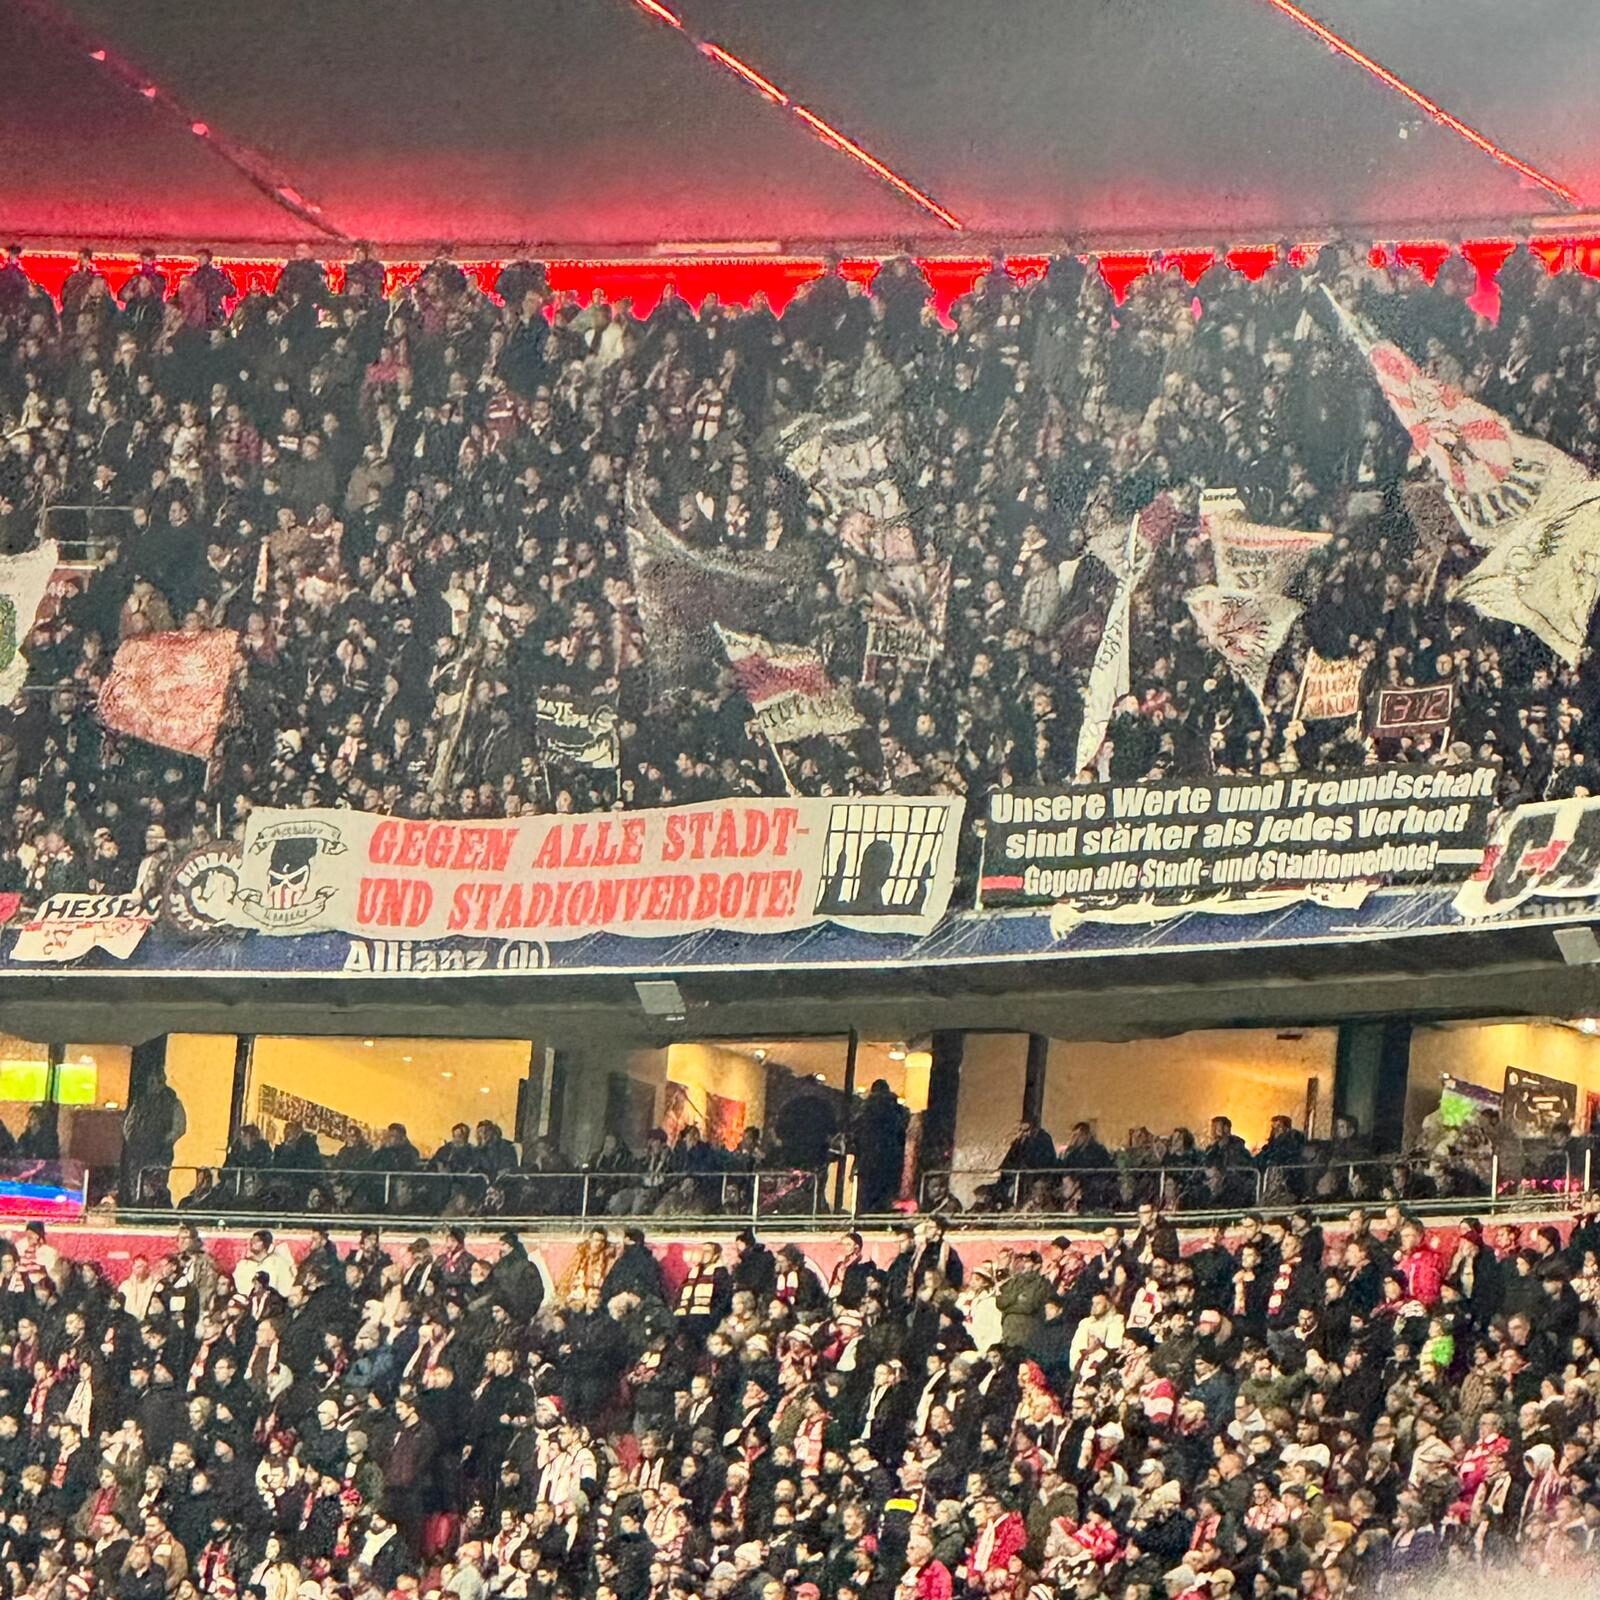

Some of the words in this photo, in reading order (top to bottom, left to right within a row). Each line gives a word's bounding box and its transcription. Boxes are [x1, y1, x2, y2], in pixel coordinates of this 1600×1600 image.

[990, 793, 1106, 824] Unsere
[1112, 786, 1212, 818] Werte
[1217, 780, 1285, 813] und
[1287, 767, 1496, 808] Freundschaft
[368, 820, 520, 872] GEGEN
[532, 817, 646, 869] ALLE
[661, 807, 810, 862] STADT-
[1005, 827, 1078, 860] sind
[1082, 822, 1200, 856] stärker
[1202, 818, 1254, 848] als
[1357, 803, 1471, 838] Verbot!
[1023, 864, 1093, 898] Gegen
[1093, 861, 1139, 891] alle
[1139, 857, 1211, 888] Stadt-
[1211, 850, 1260, 884] und
[1257, 841, 1439, 882] Stadionverbote!
[356, 877, 434, 928] UND
[447, 868, 804, 932] STADIONVERBOTE!
[343, 939, 489, 972] Allianz
